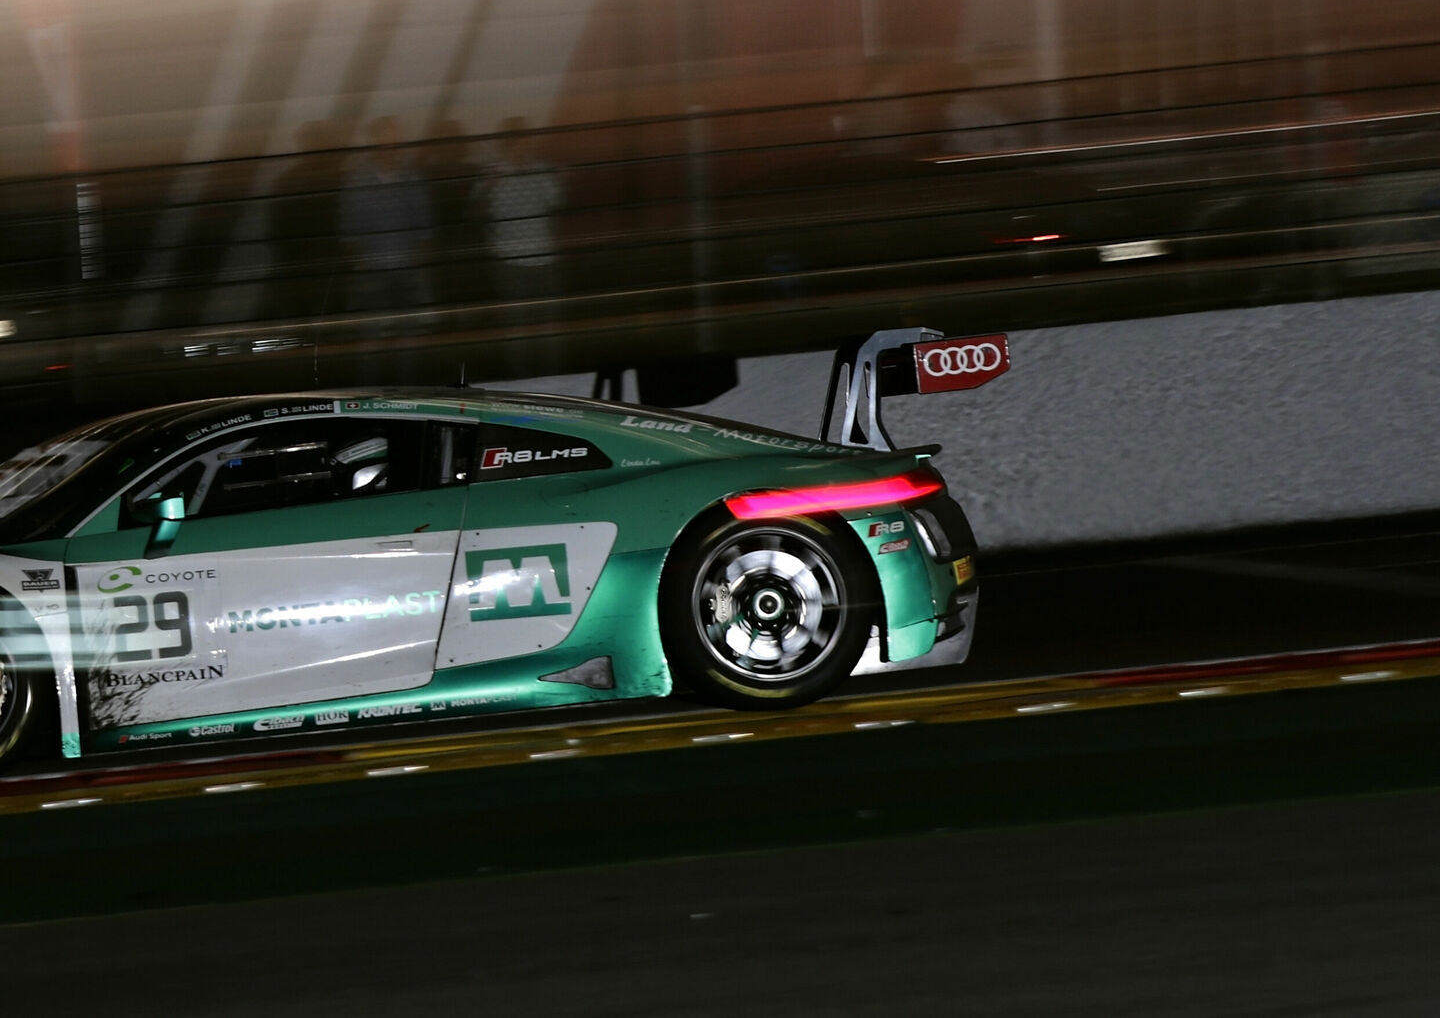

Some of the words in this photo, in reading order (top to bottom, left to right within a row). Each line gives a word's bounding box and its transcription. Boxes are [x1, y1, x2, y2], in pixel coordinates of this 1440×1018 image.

[303, 403, 334, 413] LINDE
[373, 401, 419, 411] SCHMIDT
[220, 414, 253, 428] LINDE
[620, 416, 693, 434] Land
[712, 427, 864, 455] Motorsport
[494, 449, 533, 468] R8
[533, 447, 590, 462] LMS
[873, 520, 905, 536] R8
[145, 569, 217, 584] COYOTE
[227, 590, 443, 634] MONTAPLAST
[113, 590, 193, 663] 29
[107, 664, 224, 688] BLANCPAIN
[450, 693, 518, 708] MONTAPLAST
[128, 732, 148, 741] Audi
[150, 731, 173, 742] Sport
[201, 723, 235, 736] Castrol
